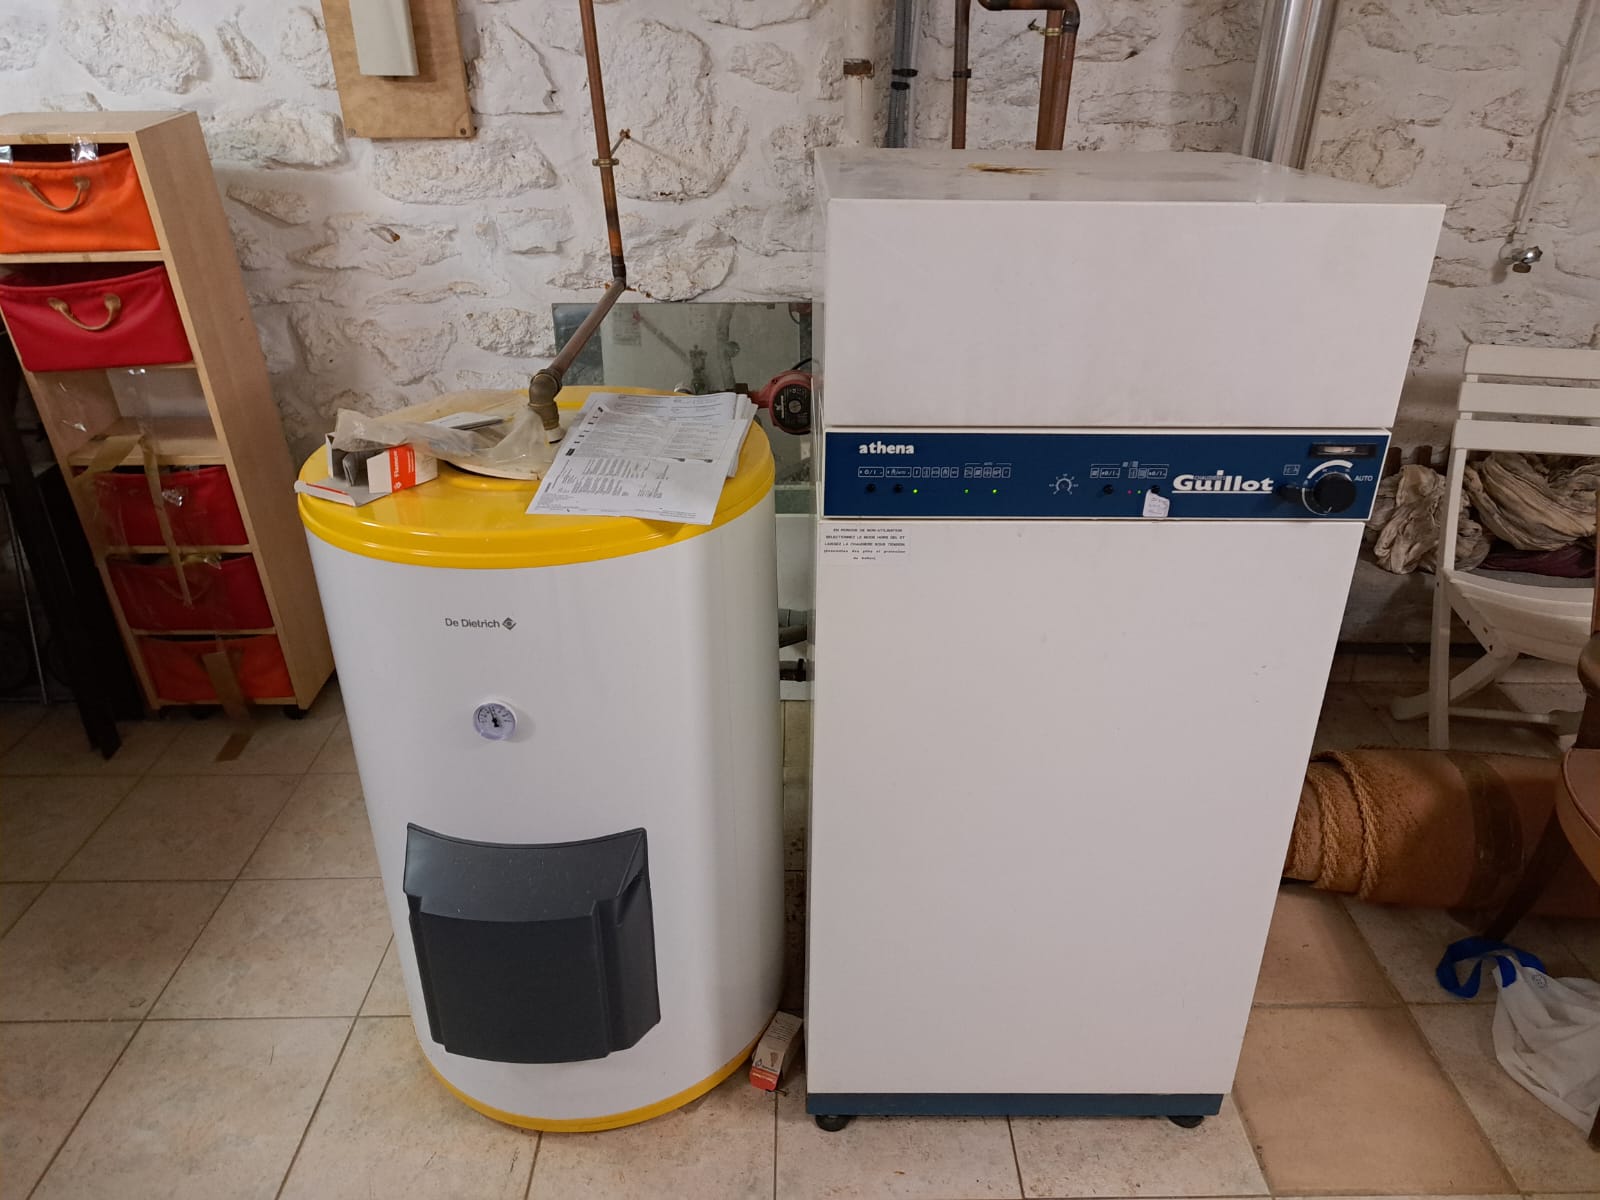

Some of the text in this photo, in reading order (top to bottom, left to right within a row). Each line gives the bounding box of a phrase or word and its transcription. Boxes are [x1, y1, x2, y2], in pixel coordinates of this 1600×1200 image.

[858, 440, 915, 455] athena
[1172, 469, 1274, 492] Guillot
[1353, 474, 1374, 482] AUTO
[444, 617, 500, 628] De Dietrich
